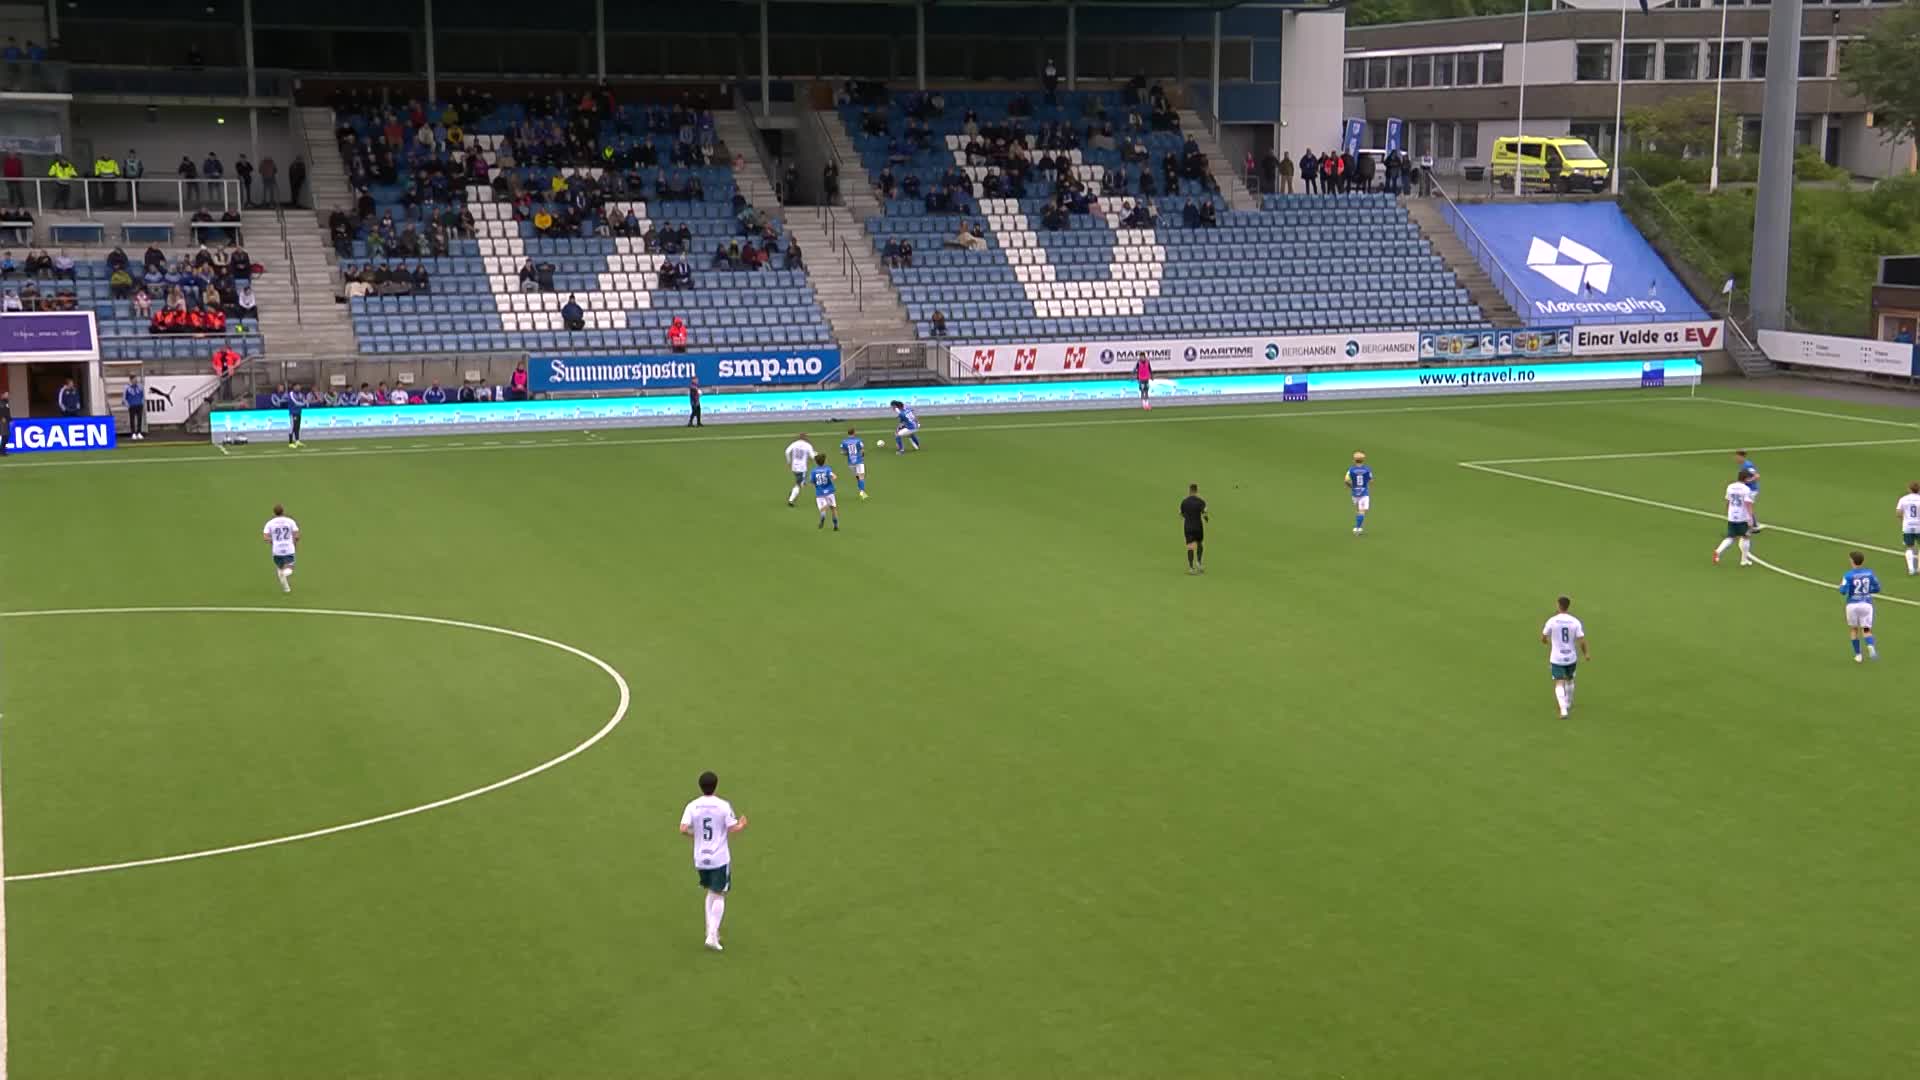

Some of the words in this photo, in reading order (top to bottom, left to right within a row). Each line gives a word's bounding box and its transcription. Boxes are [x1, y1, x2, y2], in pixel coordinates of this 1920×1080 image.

[1535, 298, 1667, 315] Møremegling
[1578, 331, 1614, 347] Einar
[1620, 329, 1659, 345] Valde
[1664, 331, 1679, 343] as
[1684, 327, 1719, 347] EV
[1199, 346, 1254, 356] MARITIME
[1281, 346, 1337, 357] BERGHANSEN
[1361, 343, 1416, 354] BERGHANSEN
[718, 355, 823, 382] smp.no
[1419, 368, 1536, 388] www.gtravel.no
[274, 526, 290, 541] 22
[702, 817, 713, 842] 5
